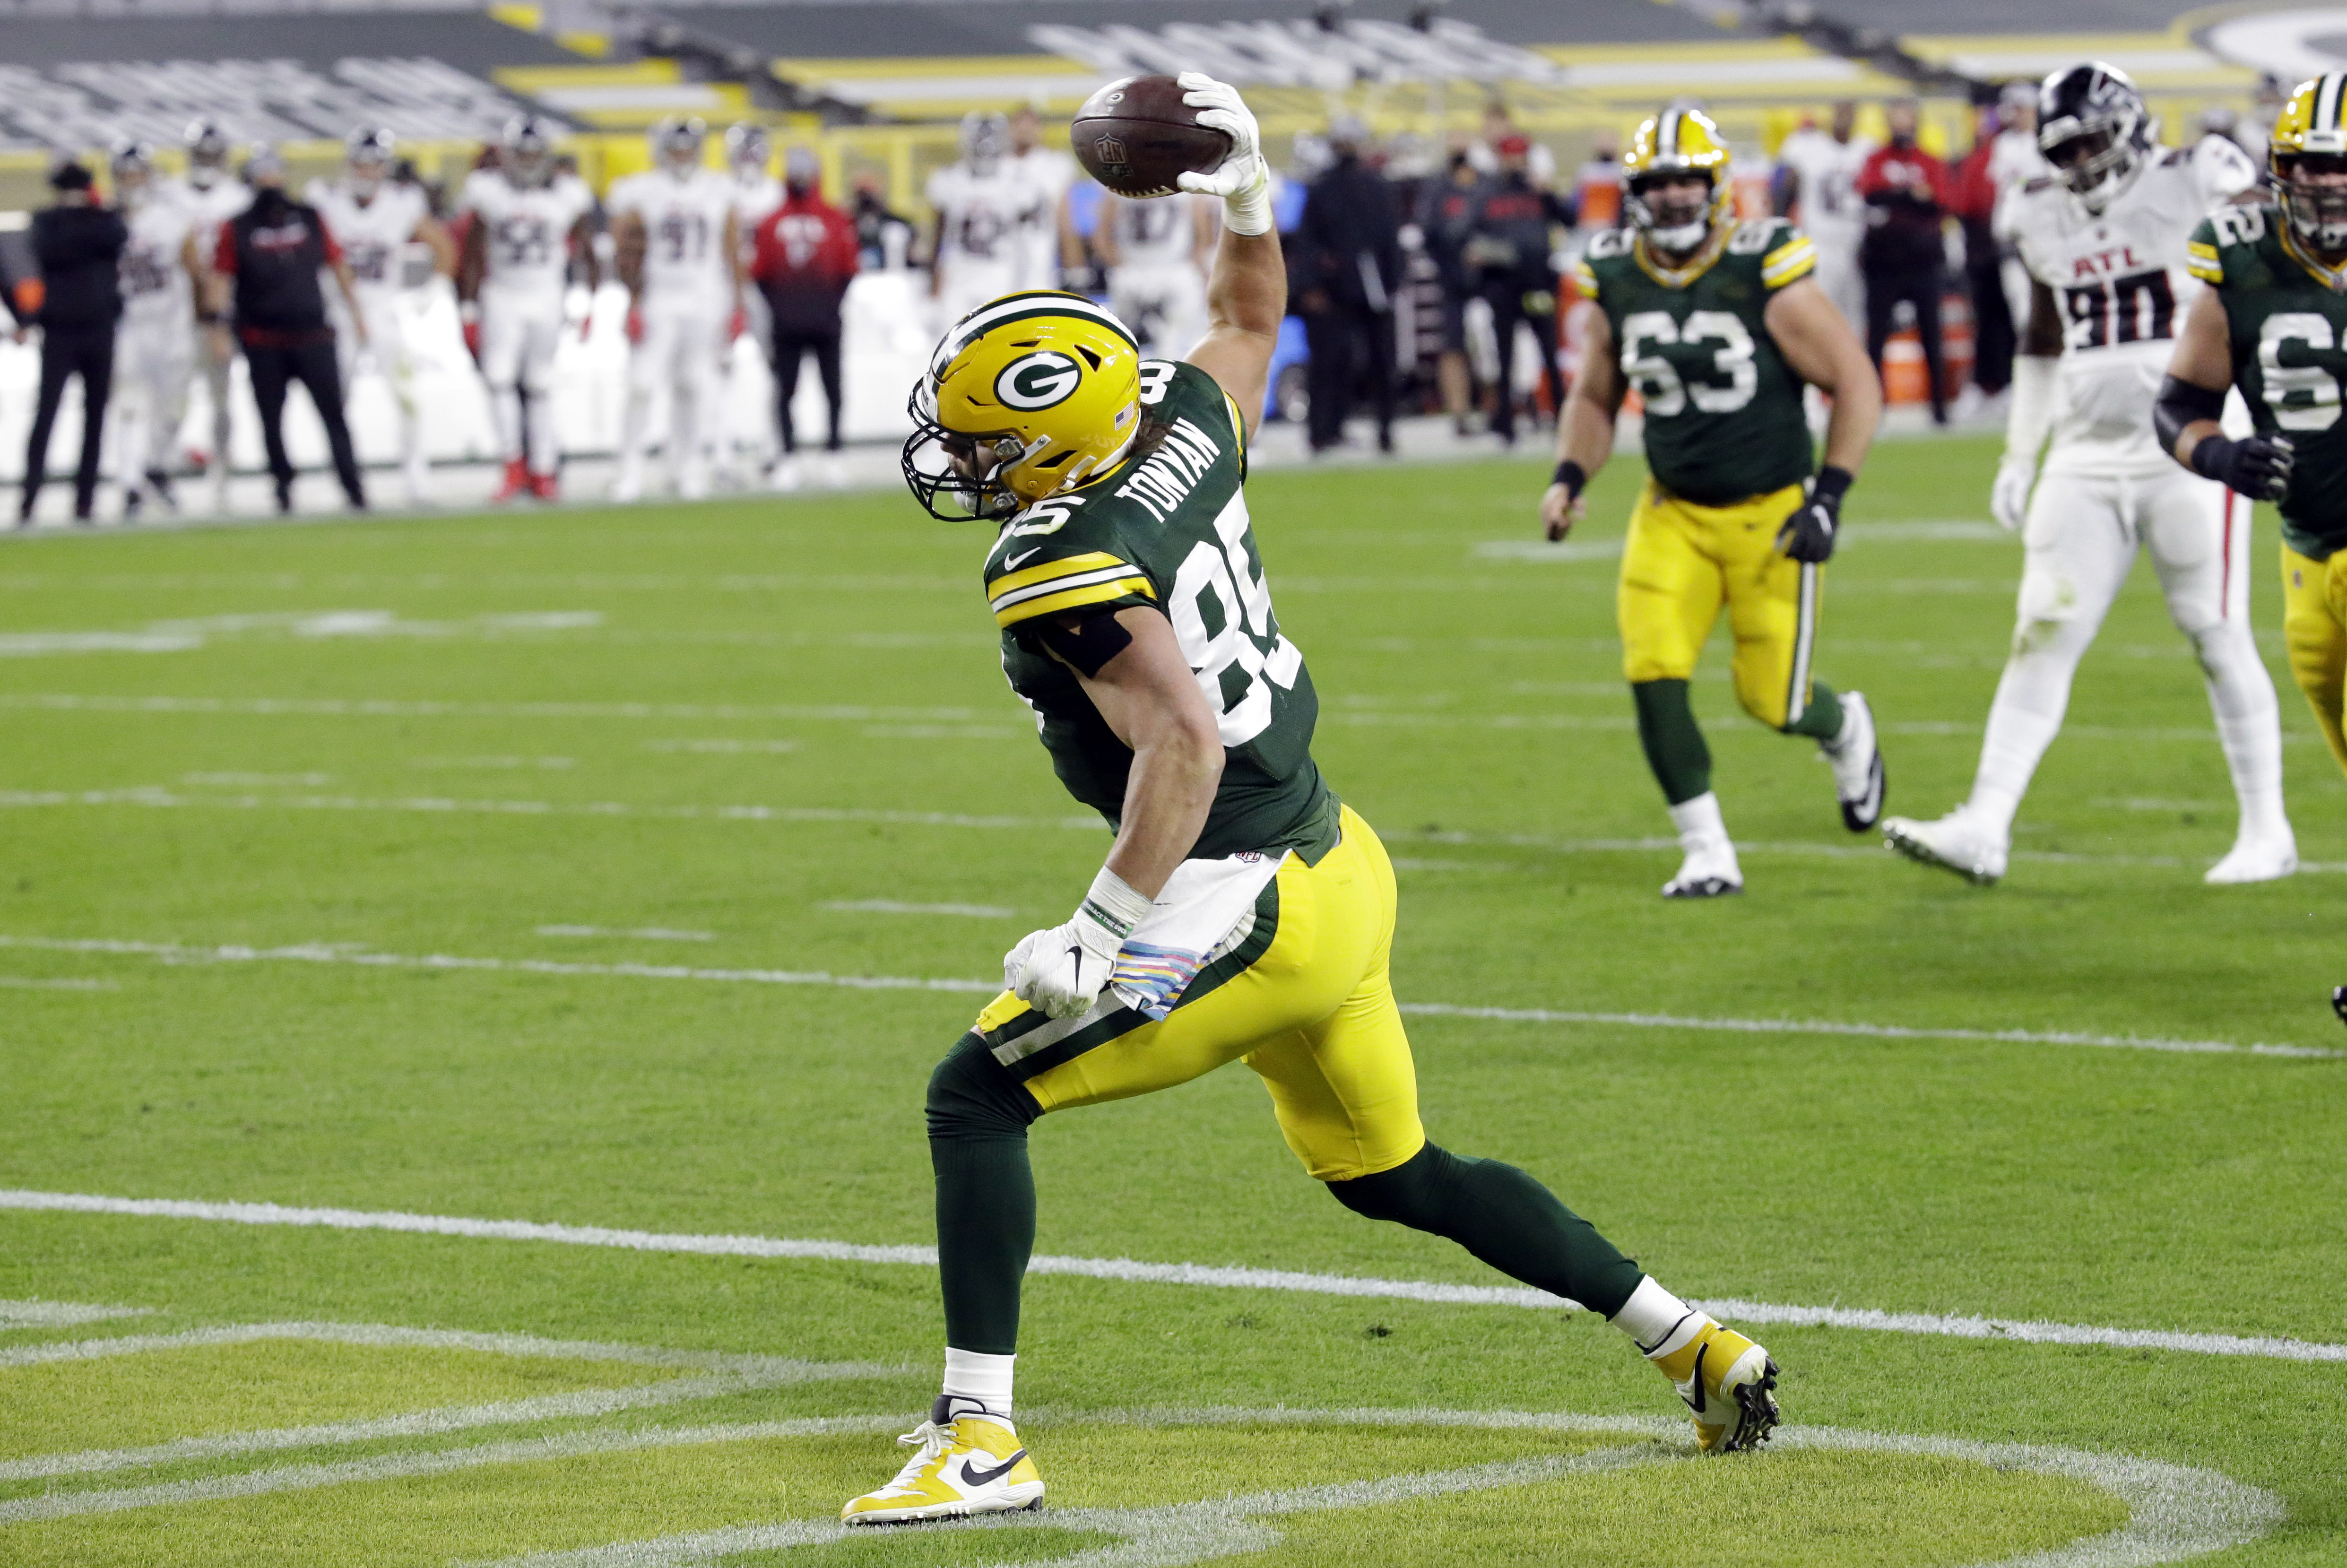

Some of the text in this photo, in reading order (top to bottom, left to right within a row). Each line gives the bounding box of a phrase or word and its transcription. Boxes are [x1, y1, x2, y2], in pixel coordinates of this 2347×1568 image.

[2071, 246, 2143, 278] ATL
[2063, 268, 2175, 350] 90
[997, 355, 1079, 408] G
[1620, 310, 1758, 416] 63
[2258, 312, 2347, 431] 6
[1114, 416, 1221, 523] TONYAN
[1168, 481, 1303, 748] 85
[1237, 852, 1258, 861] NFL
[1102, 917, 1116, 928] THE
